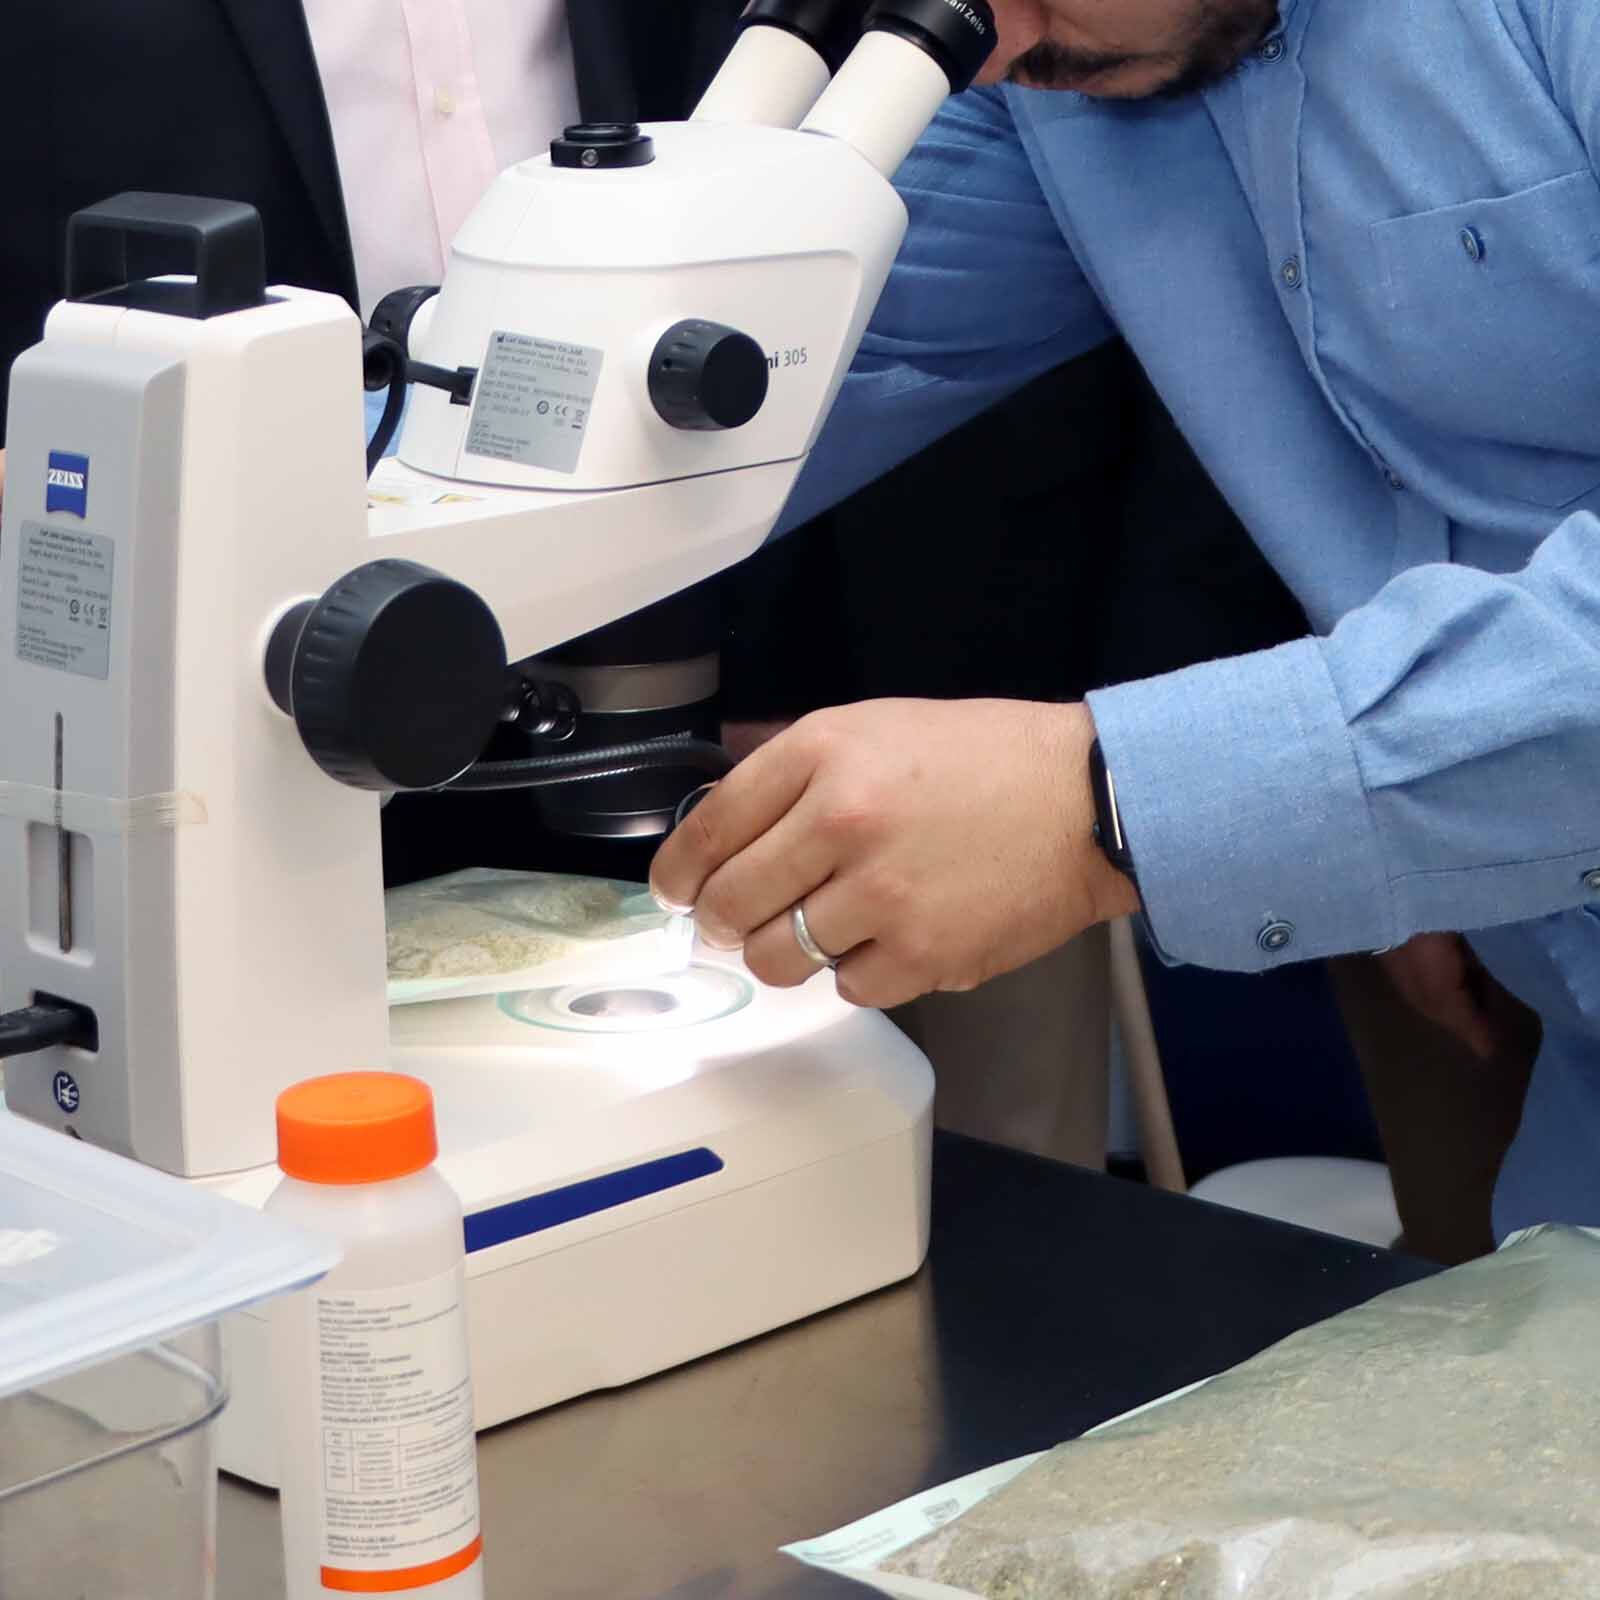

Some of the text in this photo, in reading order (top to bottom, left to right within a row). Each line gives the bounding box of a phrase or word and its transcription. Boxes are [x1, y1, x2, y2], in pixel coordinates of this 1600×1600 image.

[964, 7, 986, 35] Zeiss
[783, 347, 808, 368] 305
[47, 467, 85, 491] ZEISS
